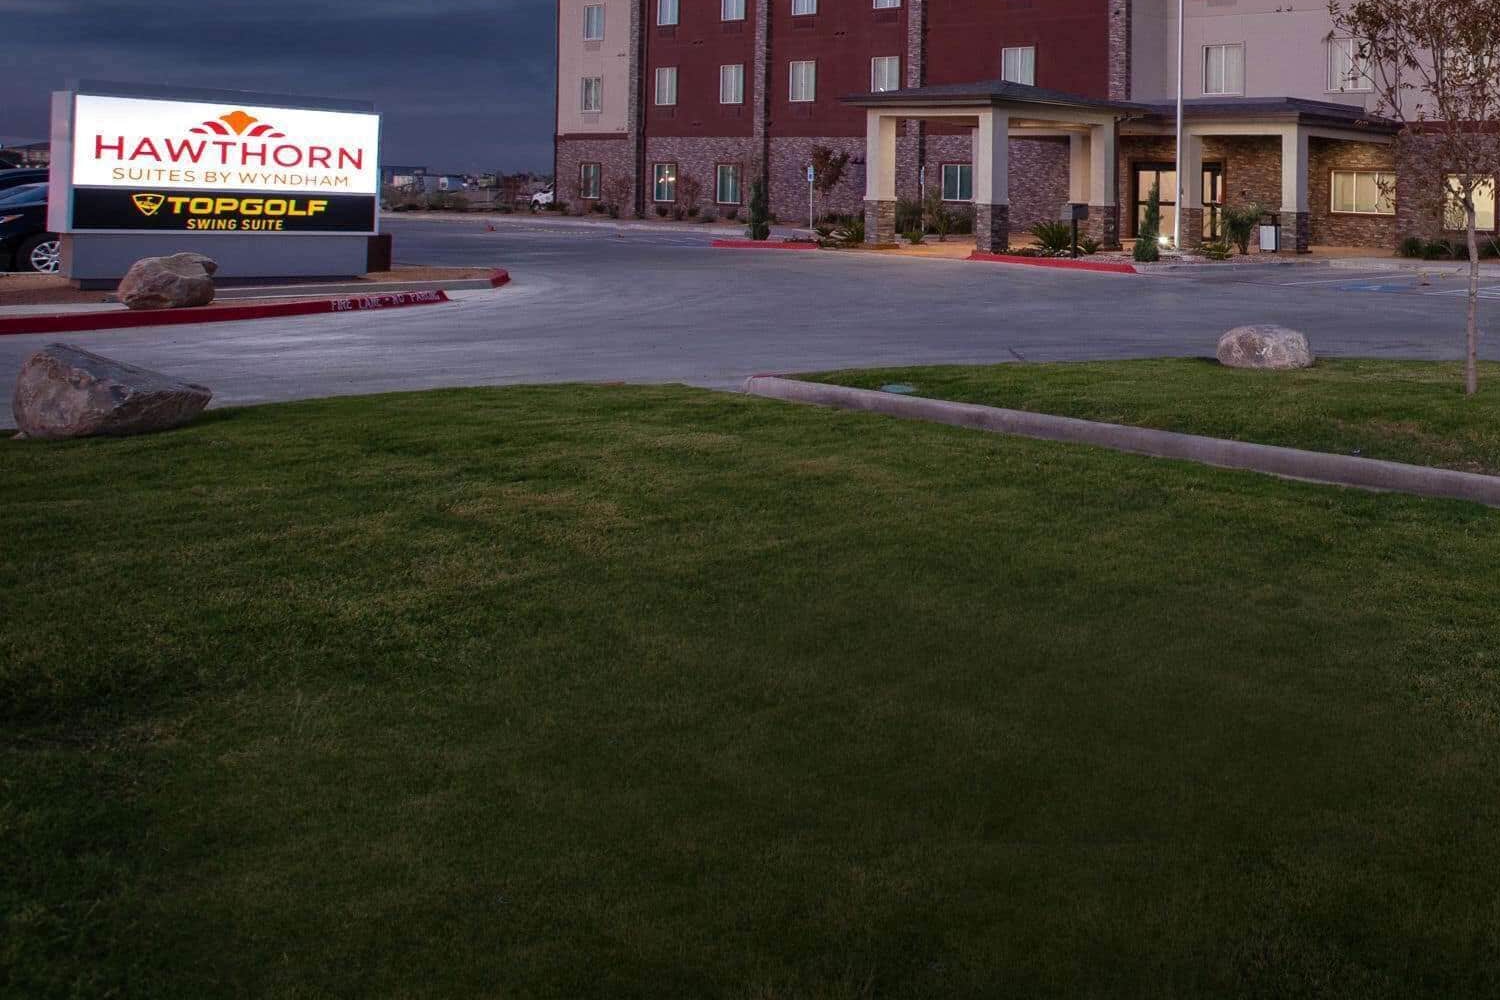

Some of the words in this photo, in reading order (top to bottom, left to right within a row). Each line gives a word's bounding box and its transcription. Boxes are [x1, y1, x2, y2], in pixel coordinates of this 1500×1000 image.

[95, 135, 363, 169] HAWTHORN
[112, 167, 195, 182] SUITES
[204, 171, 231, 183] BY
[239, 173, 348, 187] WYNDHAM
[168, 197, 328, 216] TOPGOLF
[187, 218, 236, 230] SWING
[242, 218, 283, 230] SUITE
